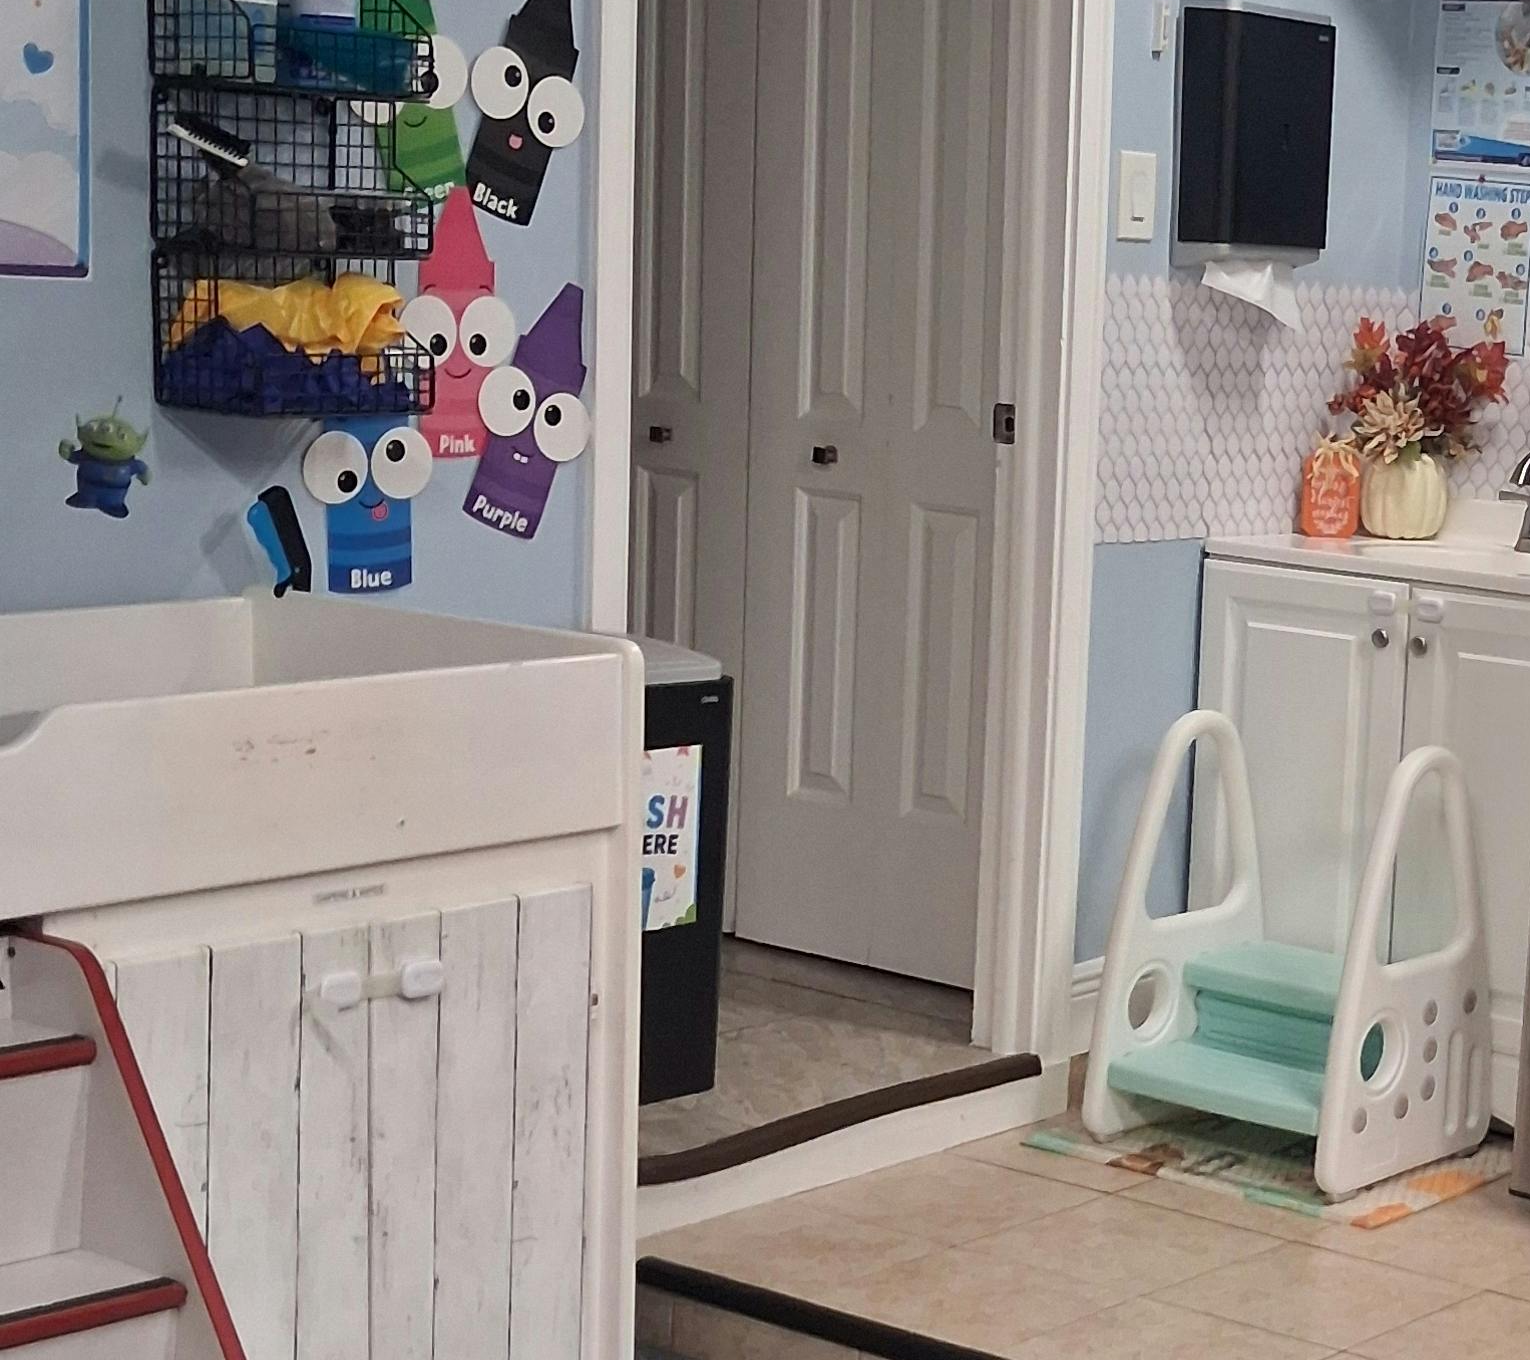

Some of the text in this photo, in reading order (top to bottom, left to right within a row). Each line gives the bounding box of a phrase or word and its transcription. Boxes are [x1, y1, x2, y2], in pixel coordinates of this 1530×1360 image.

[473, 181, 520, 220] Black
[1435, 181, 1462, 199] HAND
[1464, 183, 1508, 203] WASHING
[439, 434, 476, 454] Pink
[472, 494, 529, 533] Purple
[350, 568, 393, 589] Blue
